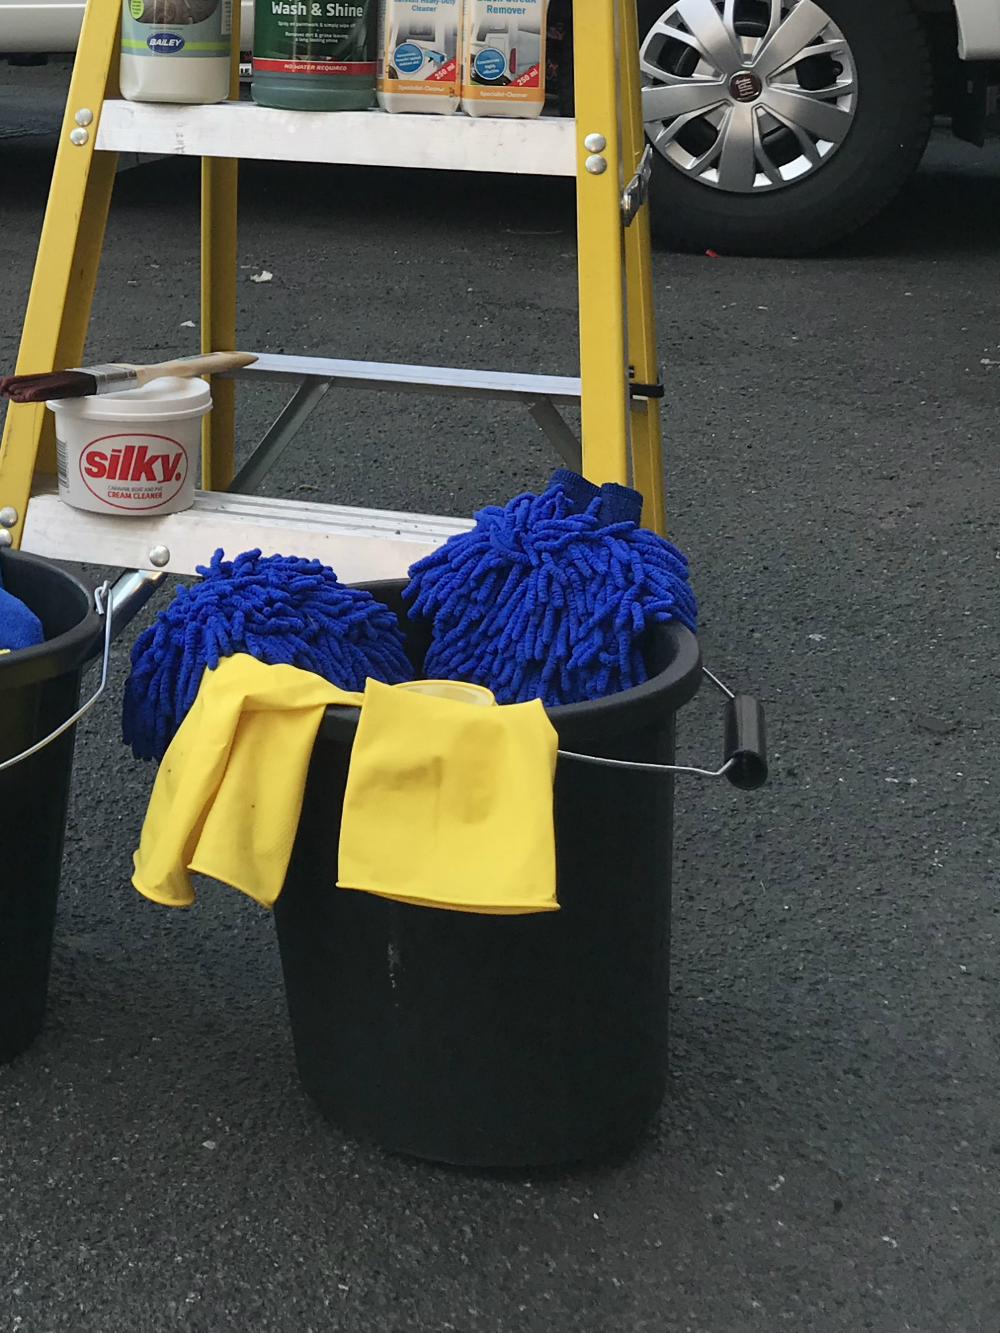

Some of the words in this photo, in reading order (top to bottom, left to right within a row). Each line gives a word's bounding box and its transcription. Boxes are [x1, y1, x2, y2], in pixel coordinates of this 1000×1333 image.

[272, 1, 306, 15] Wash
[311, 3, 322, 16] &
[326, 3, 363, 17] Shine
[487, 5, 526, 14] Remover
[149, 38, 182, 46] BAILEY
[435, 69, 447, 80] 250
[447, 63, 455, 71] ml
[517, 74, 530, 86] 250
[530, 68, 538, 77] ml
[108, 491, 132, 499] CREAM
